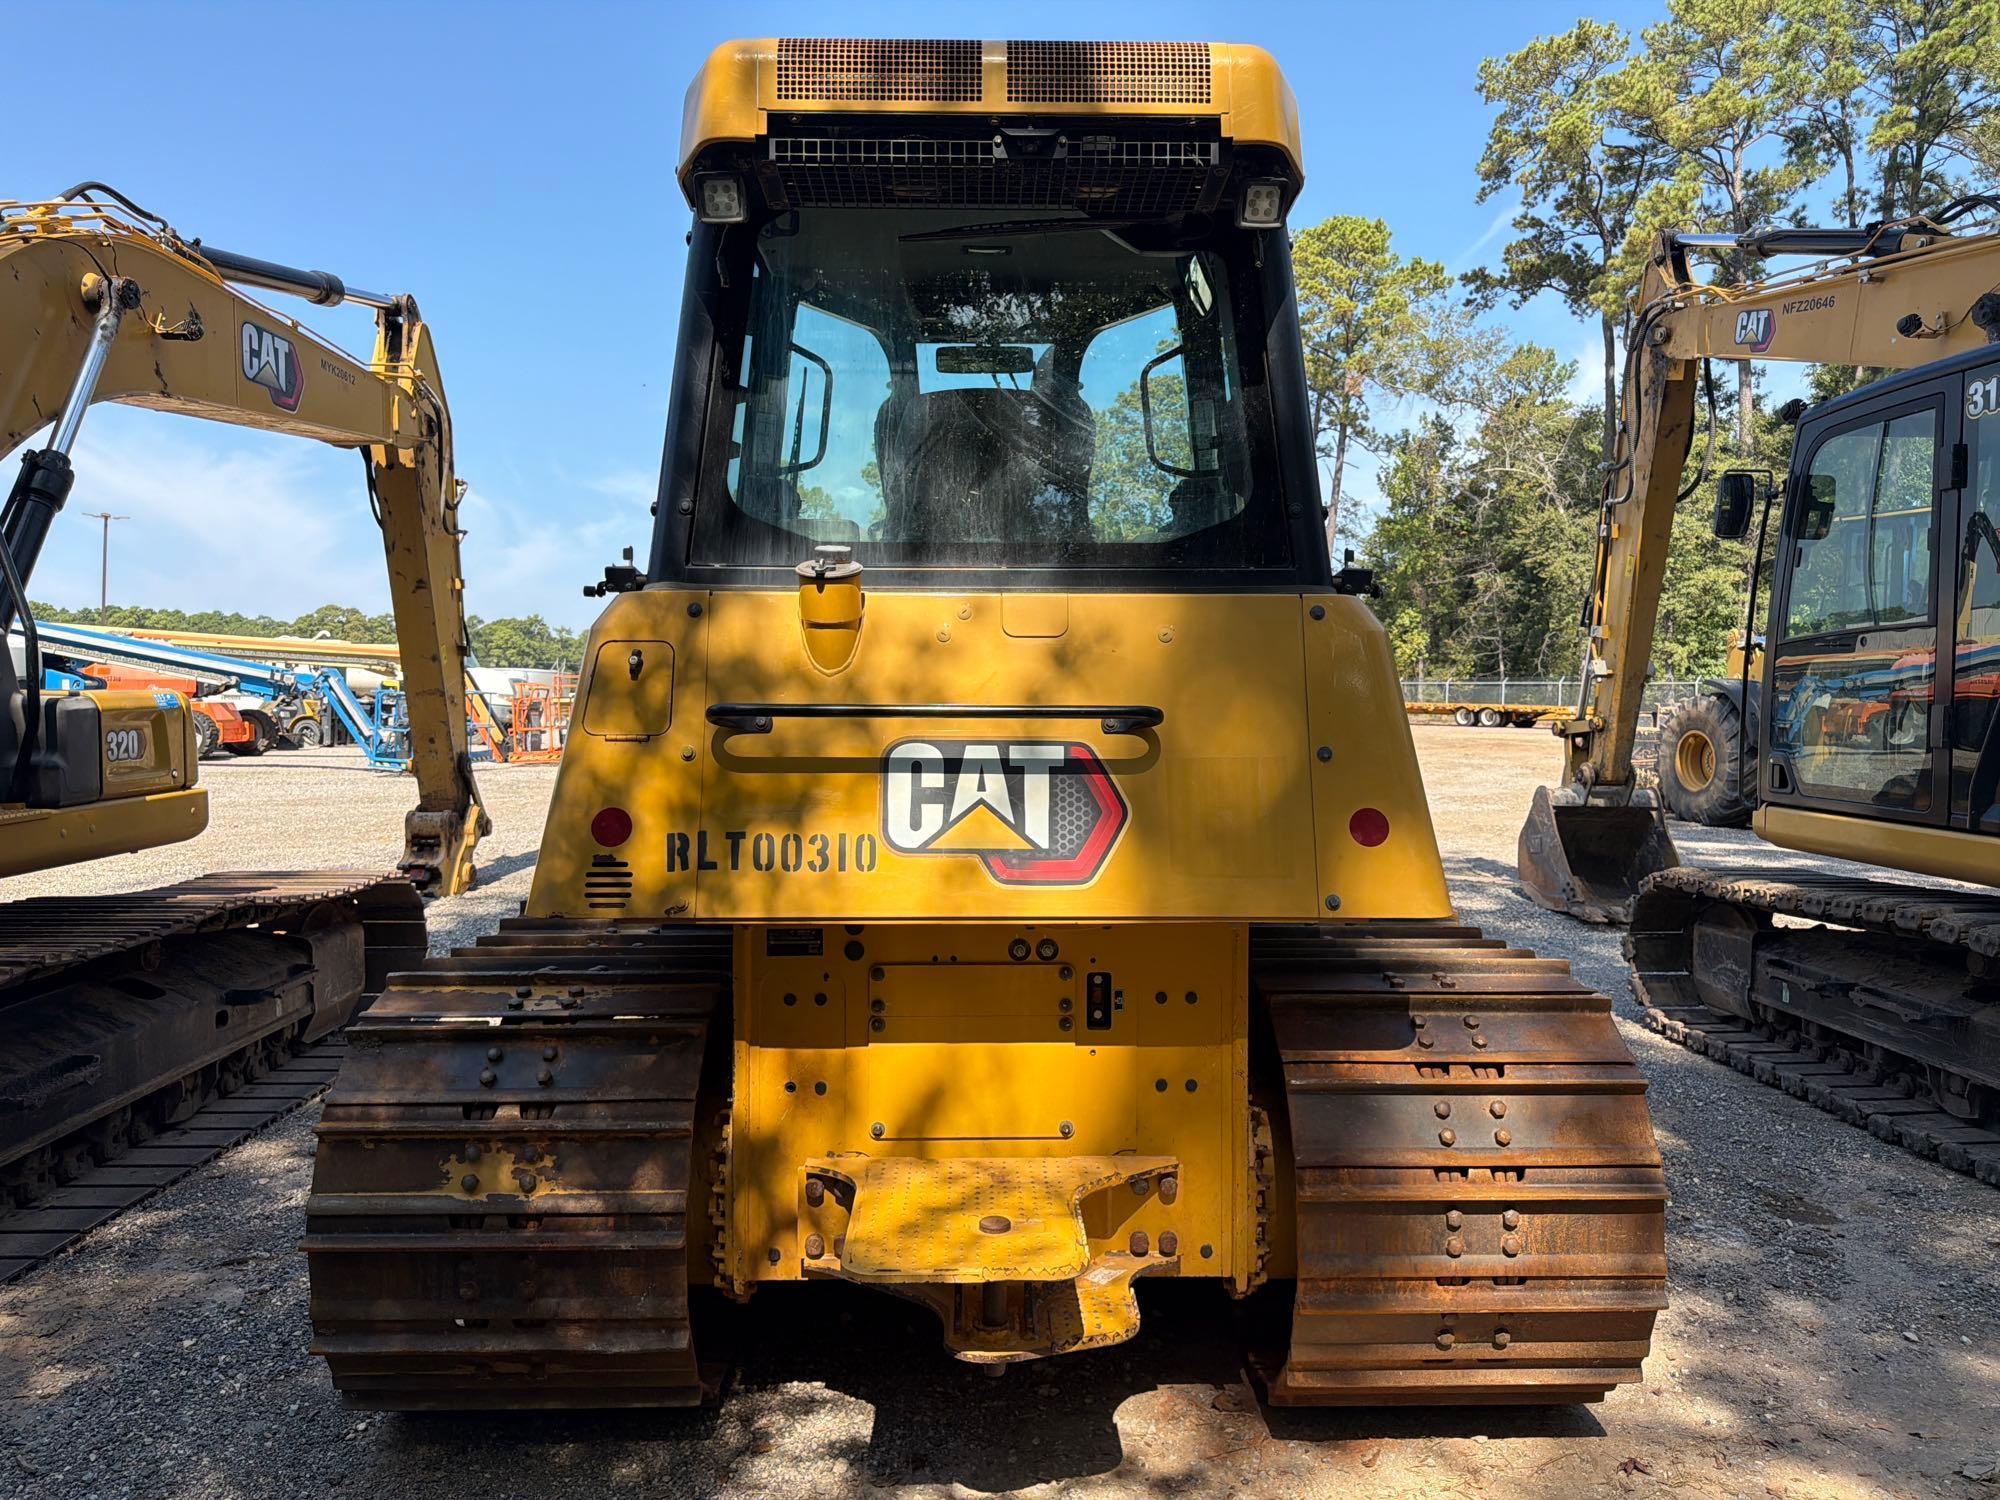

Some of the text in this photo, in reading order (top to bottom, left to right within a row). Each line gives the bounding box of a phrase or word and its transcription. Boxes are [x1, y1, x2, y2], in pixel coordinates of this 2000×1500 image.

[1782, 295, 1836, 315] NFZ20646
[1735, 310, 1768, 344] CAT
[242, 322, 289, 393] CAT
[106, 730, 139, 761] 320
[887, 742, 1065, 850] CAT
[665, 831, 877, 873] RLT00310
